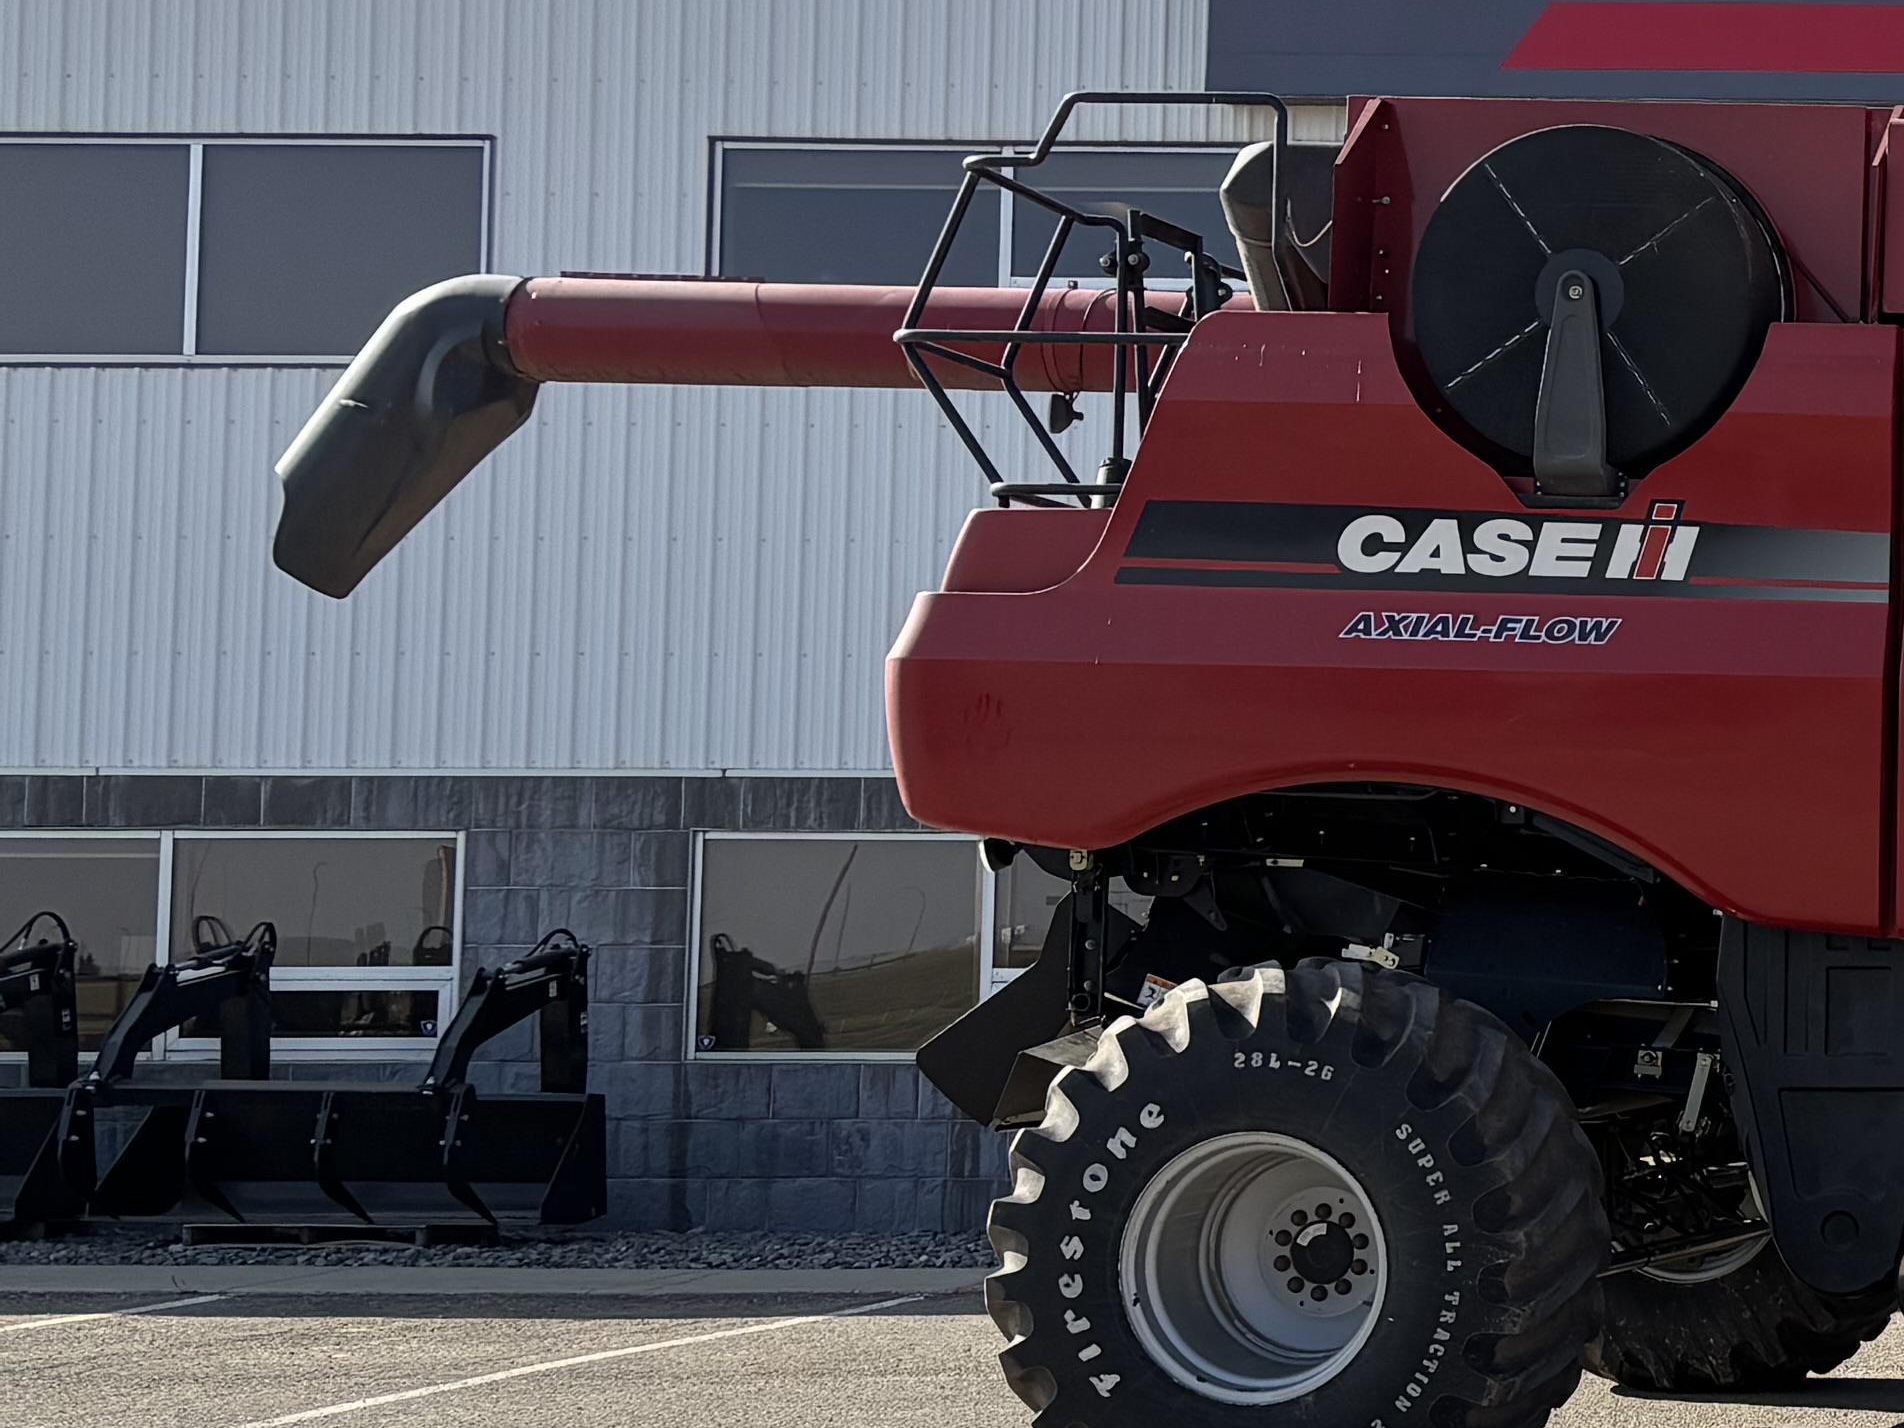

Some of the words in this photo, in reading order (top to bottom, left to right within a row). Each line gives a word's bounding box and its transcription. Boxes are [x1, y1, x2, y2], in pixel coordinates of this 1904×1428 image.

[1337, 514, 1602, 577] CASE
[1339, 611, 1622, 645] AXIAL-FLOW
[1233, 1051, 1335, 1081] 28L-26
[1395, 1123, 1453, 1205] SUPER
[1058, 1102, 1165, 1398] Firestone
[1442, 1223, 1462, 1272] ALL
[1395, 1291, 1461, 1413] TRACTION
